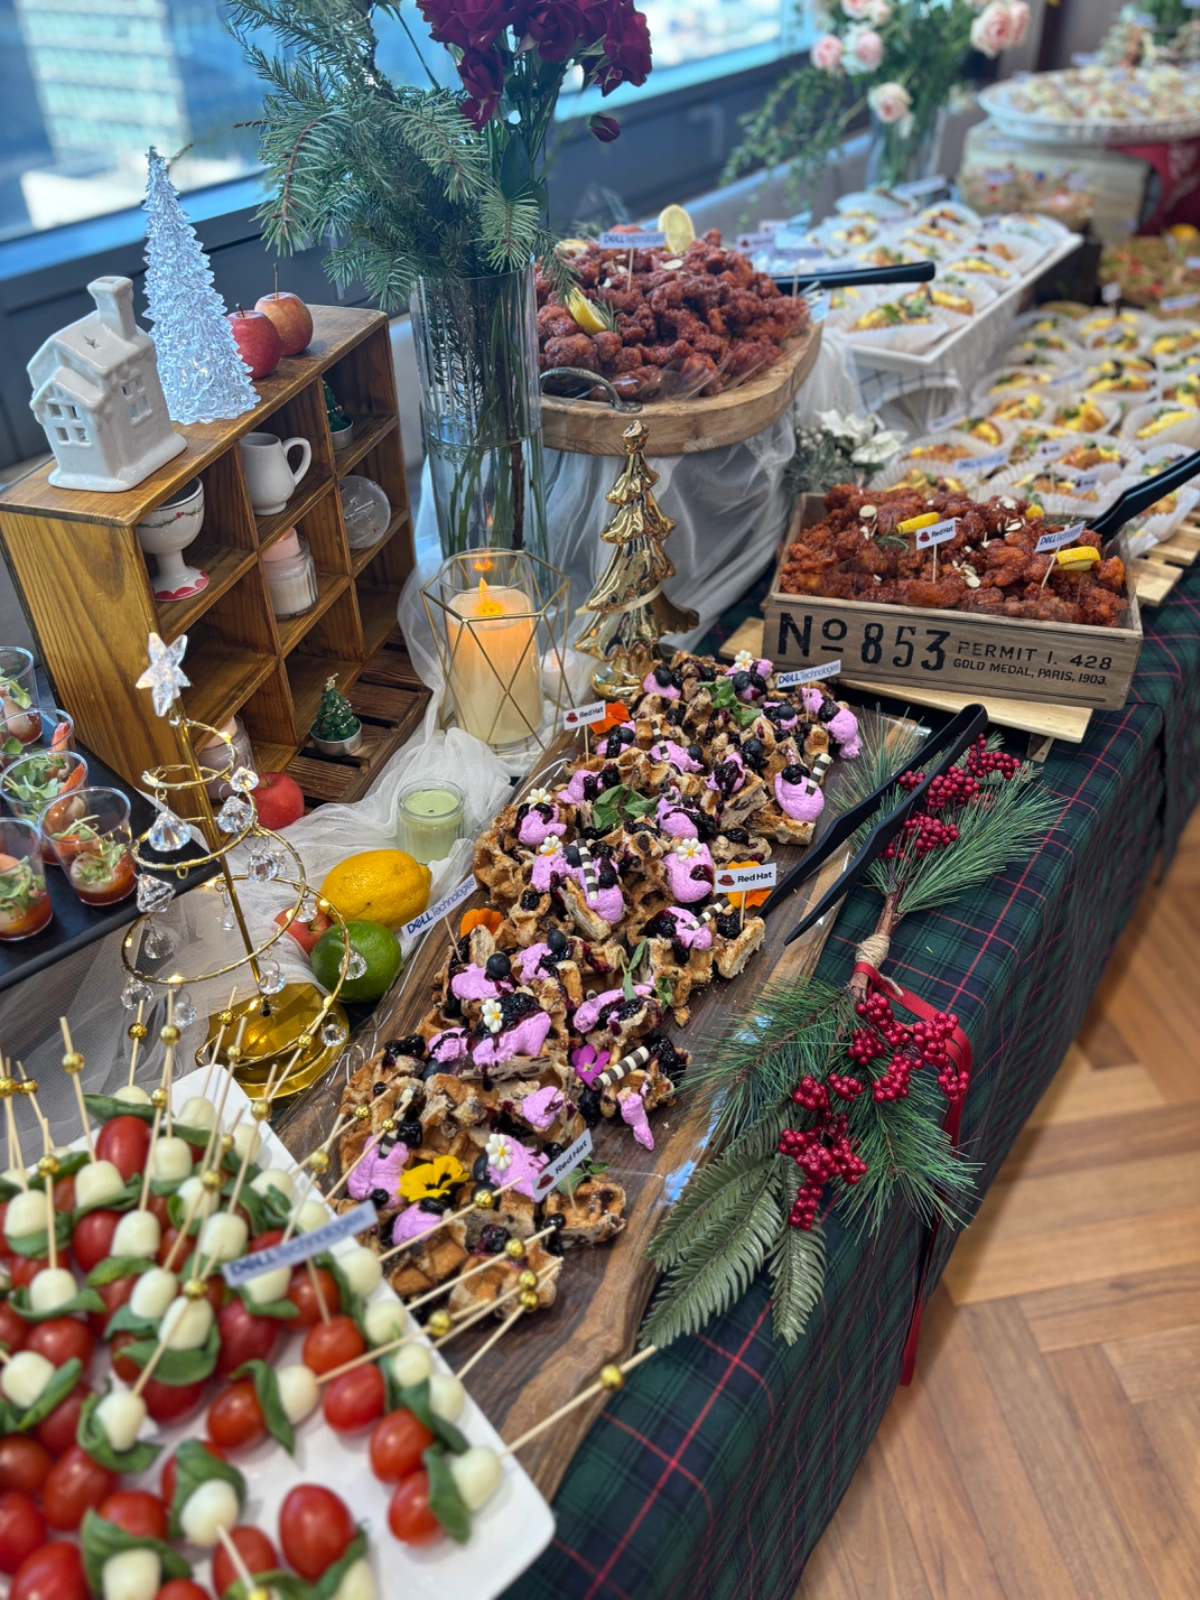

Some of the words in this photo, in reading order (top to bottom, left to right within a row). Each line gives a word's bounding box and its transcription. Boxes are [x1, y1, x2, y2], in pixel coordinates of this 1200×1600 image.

[860, 622, 951, 671] 853
[957, 640, 1038, 662] PERMIT
[1069, 654, 1113, 671] 428
[778, 672, 801, 684] DELL
[800, 663, 840, 681] Technologies
[953, 658, 986, 671] GOLD
[989, 662, 1034, 679] MEDAL,
[1037, 668, 1075, 683] PARIS,
[579, 709, 592, 719] Red
[592, 706, 604, 716] Hat
[737, 873, 756, 883] Red
[756, 871, 773, 881] Hat
[406, 912, 433, 935] DELL
[430, 877, 475, 918] Technologies
[555, 1154, 573, 1175] Red
[572, 1140, 588, 1158] Hat
